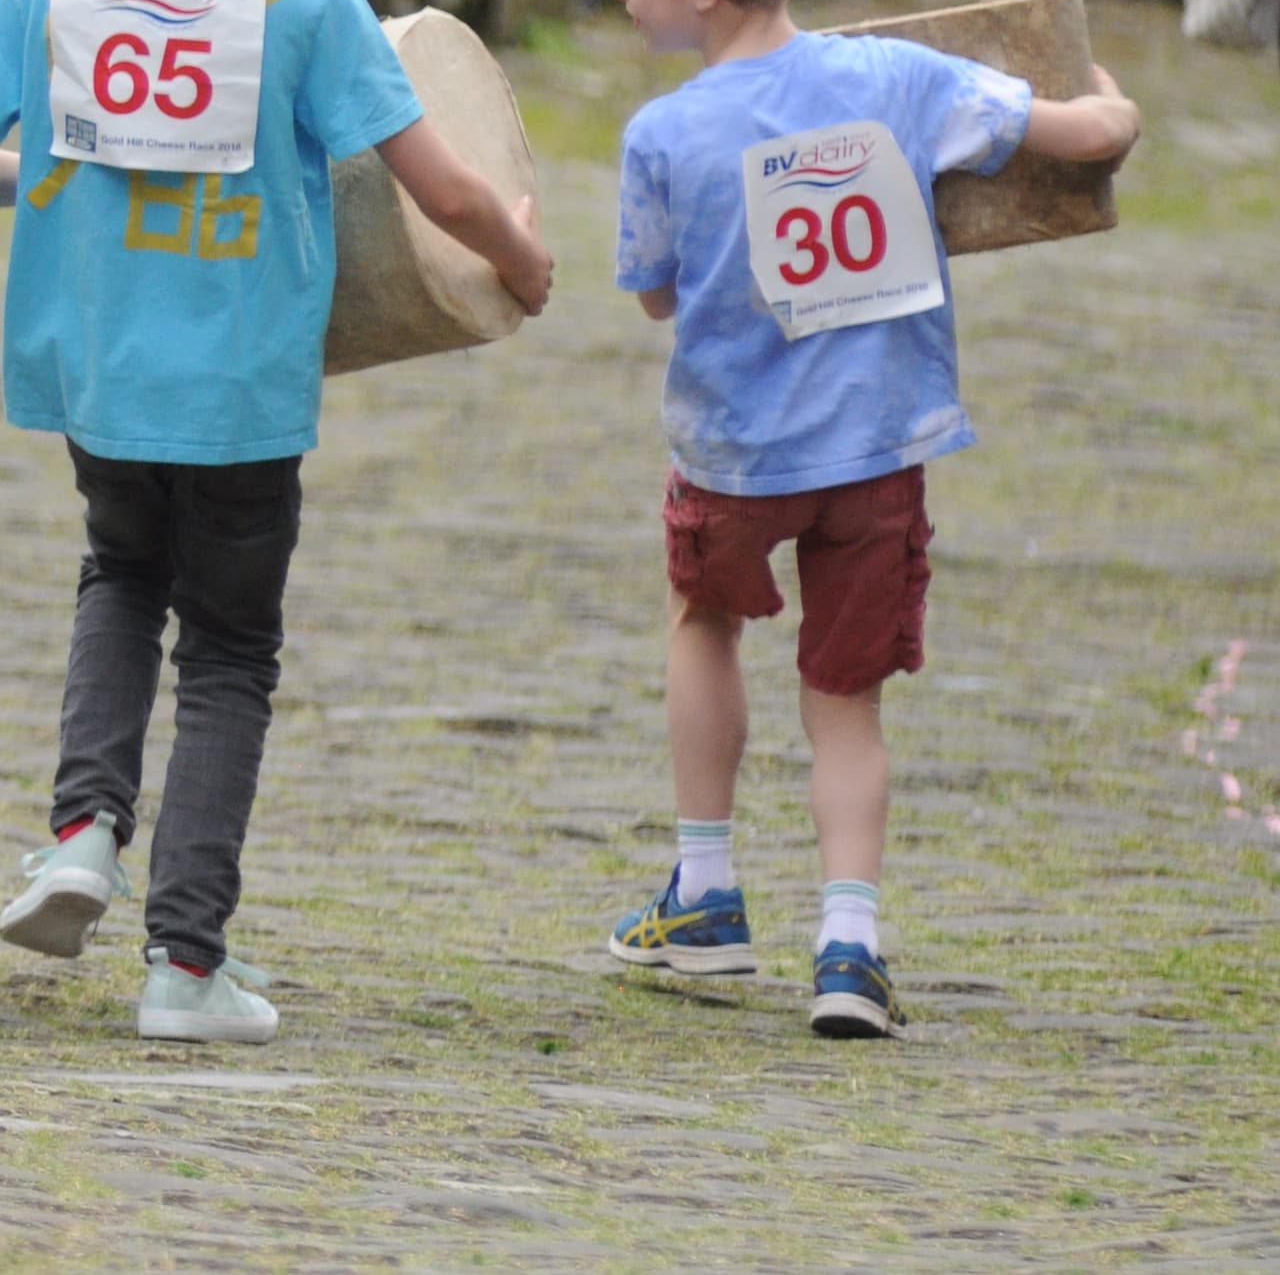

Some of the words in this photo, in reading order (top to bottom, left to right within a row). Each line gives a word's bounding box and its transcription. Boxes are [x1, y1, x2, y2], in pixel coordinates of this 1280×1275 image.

[93, 32, 213, 120] 65
[146, 138, 186, 150] Cheese
[763, 135, 877, 177] BVdairy
[775, 194, 888, 286] 30
